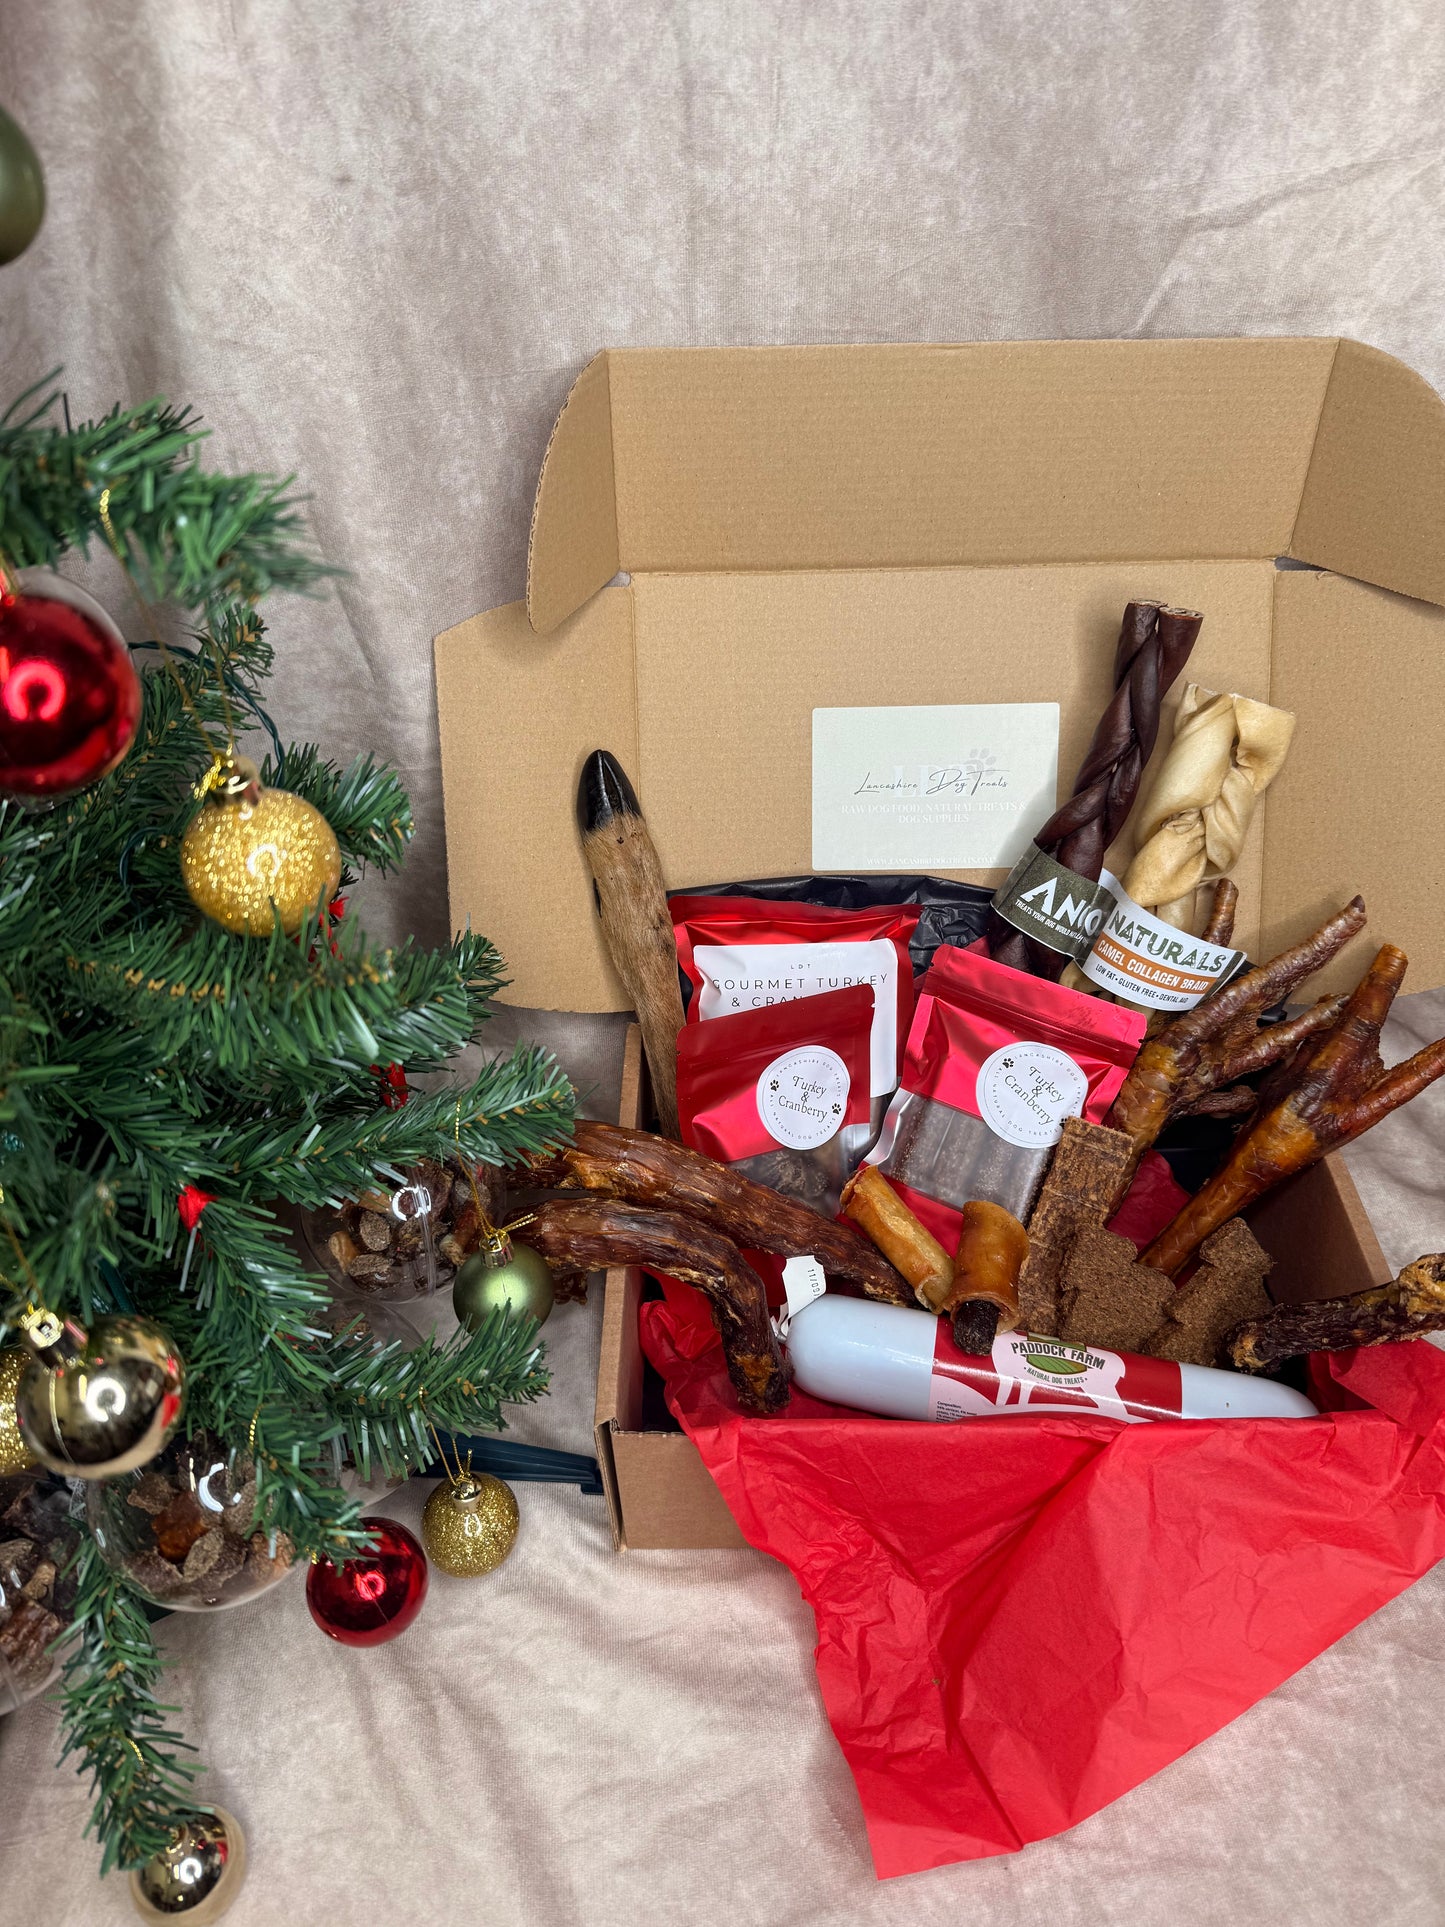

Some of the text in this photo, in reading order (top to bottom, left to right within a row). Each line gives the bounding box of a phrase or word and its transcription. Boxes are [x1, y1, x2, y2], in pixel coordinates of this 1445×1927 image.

[854, 768, 1010, 796] Lancashire Dog Treats
[1014, 899, 1033, 915] TREATS
[1032, 909, 1047, 923] YOUR
[1044, 918, 1056, 929] DOG
[1108, 910, 1227, 972] NATURALS
[1097, 940, 1209, 991] CAMEL COLLAGEN BRAID
[711, 973, 888, 991] GOURMET TURKEY
[1095, 963, 1106, 974] LOW
[1105, 970, 1116, 981] FAT
[1118, 977, 1141, 993] GLUTEN
[1142, 986, 1156, 999] FREE
[1159, 994, 1179, 1004] DENTAL
[731, 994, 804, 1007] & CRA
[792, 1075, 827, 1099] Turkey
[800, 1091, 810, 1102] &
[1028, 1066, 1065, 1103] Turkey
[1031, 1085, 1043, 1098] &
[778, 1095, 828, 1123] Cranberry
[1004, 1074, 1054, 1126] Cranberry
[807, 1268, 821, 1300] 11/09/
[1010, 1342, 1106, 1370] PADDOCK FARM
[1026, 1367, 1050, 1382] NATURAL
[1063, 1376, 1085, 1385] TREATS
